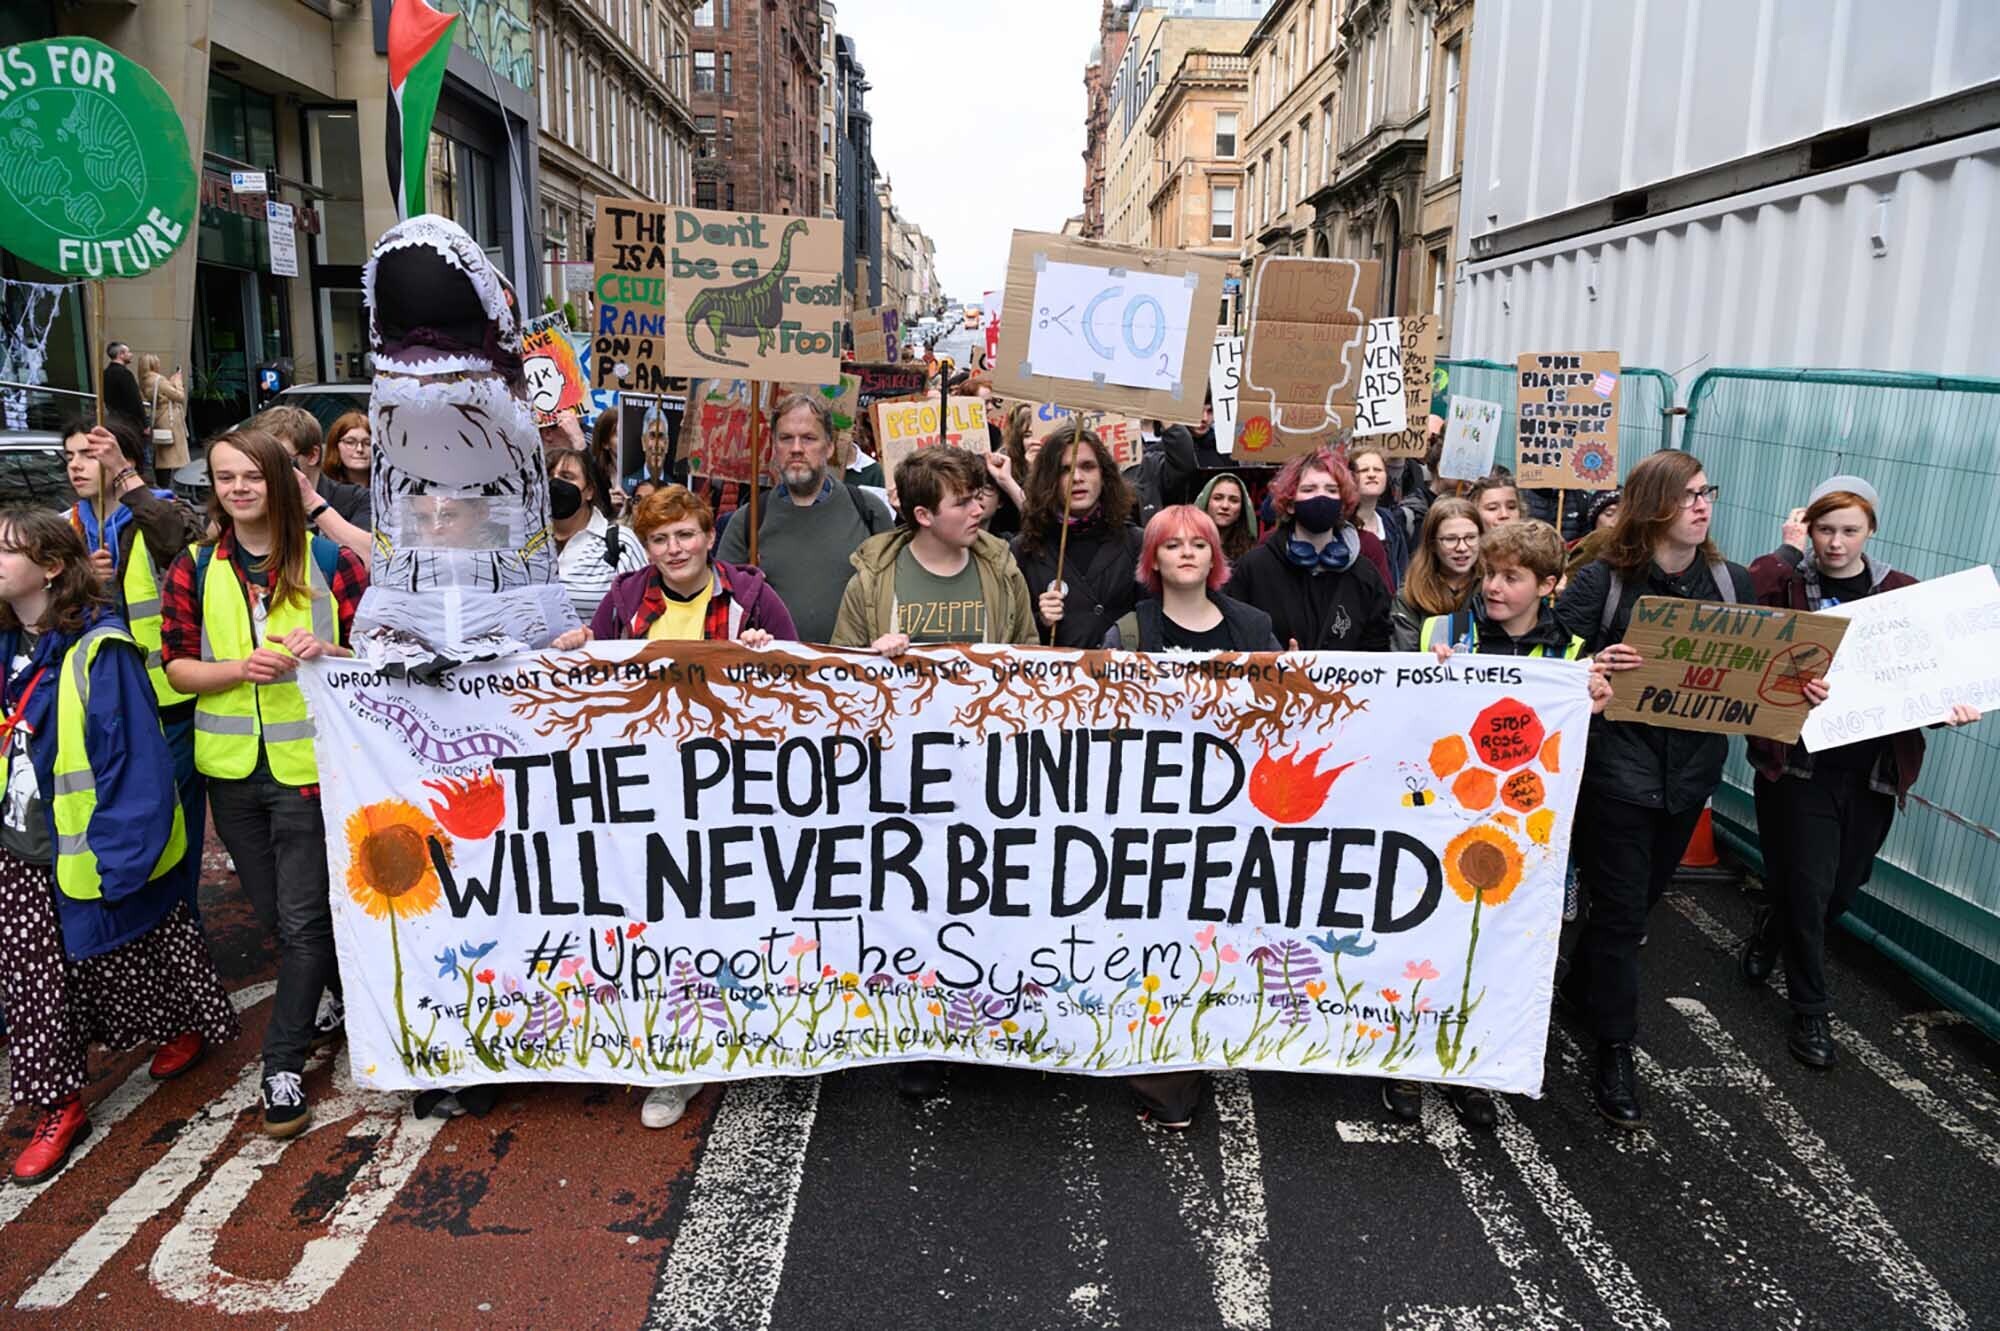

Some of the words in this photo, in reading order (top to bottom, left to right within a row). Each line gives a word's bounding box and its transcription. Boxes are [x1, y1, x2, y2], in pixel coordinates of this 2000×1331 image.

[46, 45, 117, 94] FOR
[59, 206, 183, 276] FUTURE
[674, 210, 769, 249] Don't
[611, 243, 646, 272] IS
[671, 247, 720, 280] be
[731, 257, 760, 279] a
[781, 271, 843, 306] Fossil
[595, 336, 631, 357] ON
[636, 338, 654, 359] A
[779, 320, 841, 359] Fool
[1538, 355, 1581, 370] THE
[1521, 372, 1596, 388] PLANET
[1546, 388, 1567, 402] IS
[1521, 402, 1613, 418] GETTING
[1519, 419, 1606, 437] HOTTER
[1519, 436, 1574, 450] THAN
[1520, 452, 1562, 468] ME!
[1636, 601, 1685, 628] WE
[1688, 607, 1773, 640] WANT
[1775, 614, 1798, 642] A
[1655, 635, 1773, 673] SOLUTION
[327, 668, 393, 690] UPROOT
[458, 669, 542, 699] UPROOT
[549, 662, 706, 688] CAPITALISM
[727, 661, 811, 685] UPROOT
[817, 659, 971, 684] COLONIALISM
[991, 660, 1079, 684] UPROOT
[1091, 660, 1151, 682] WHITE
[1158, 660, 1289, 684] SUPREMACY
[1308, 665, 1388, 686] UPROOT
[1396, 665, 1460, 688] FOSSIL
[1464, 665, 1524, 685] FUELS
[1682, 665, 1732, 691] NOT
[1636, 685, 1759, 726] POLLUTION
[1490, 713, 1531, 733] STOP
[1821, 705, 1890, 742] NOT
[1480, 732, 1524, 749] ROSE
[1489, 744, 1531, 762] BANK
[494, 744, 656, 830] THE
[680, 731, 957, 820] PEOPLE
[985, 729, 1247, 819] UNITED
[428, 830, 627, 918] WILL
[645, 818, 928, 922] NEVER
[946, 823, 1037, 918] BE
[1050, 825, 1444, 933] DEFEATED
[431, 1002, 469, 1020] THE
[476, 989, 544, 1014] PEOPLE
[560, 983, 596, 1000] THE
[681, 982, 720, 1001] THE
[728, 981, 818, 1002] WORKERS
[825, 979, 857, 997] THE
[1162, 994, 1193, 1010] THE
[1316, 998, 1469, 1025] COMMUNITIES
[591, 1031, 631, 1050] ONE
[716, 1029, 793, 1051] GLOBAL
